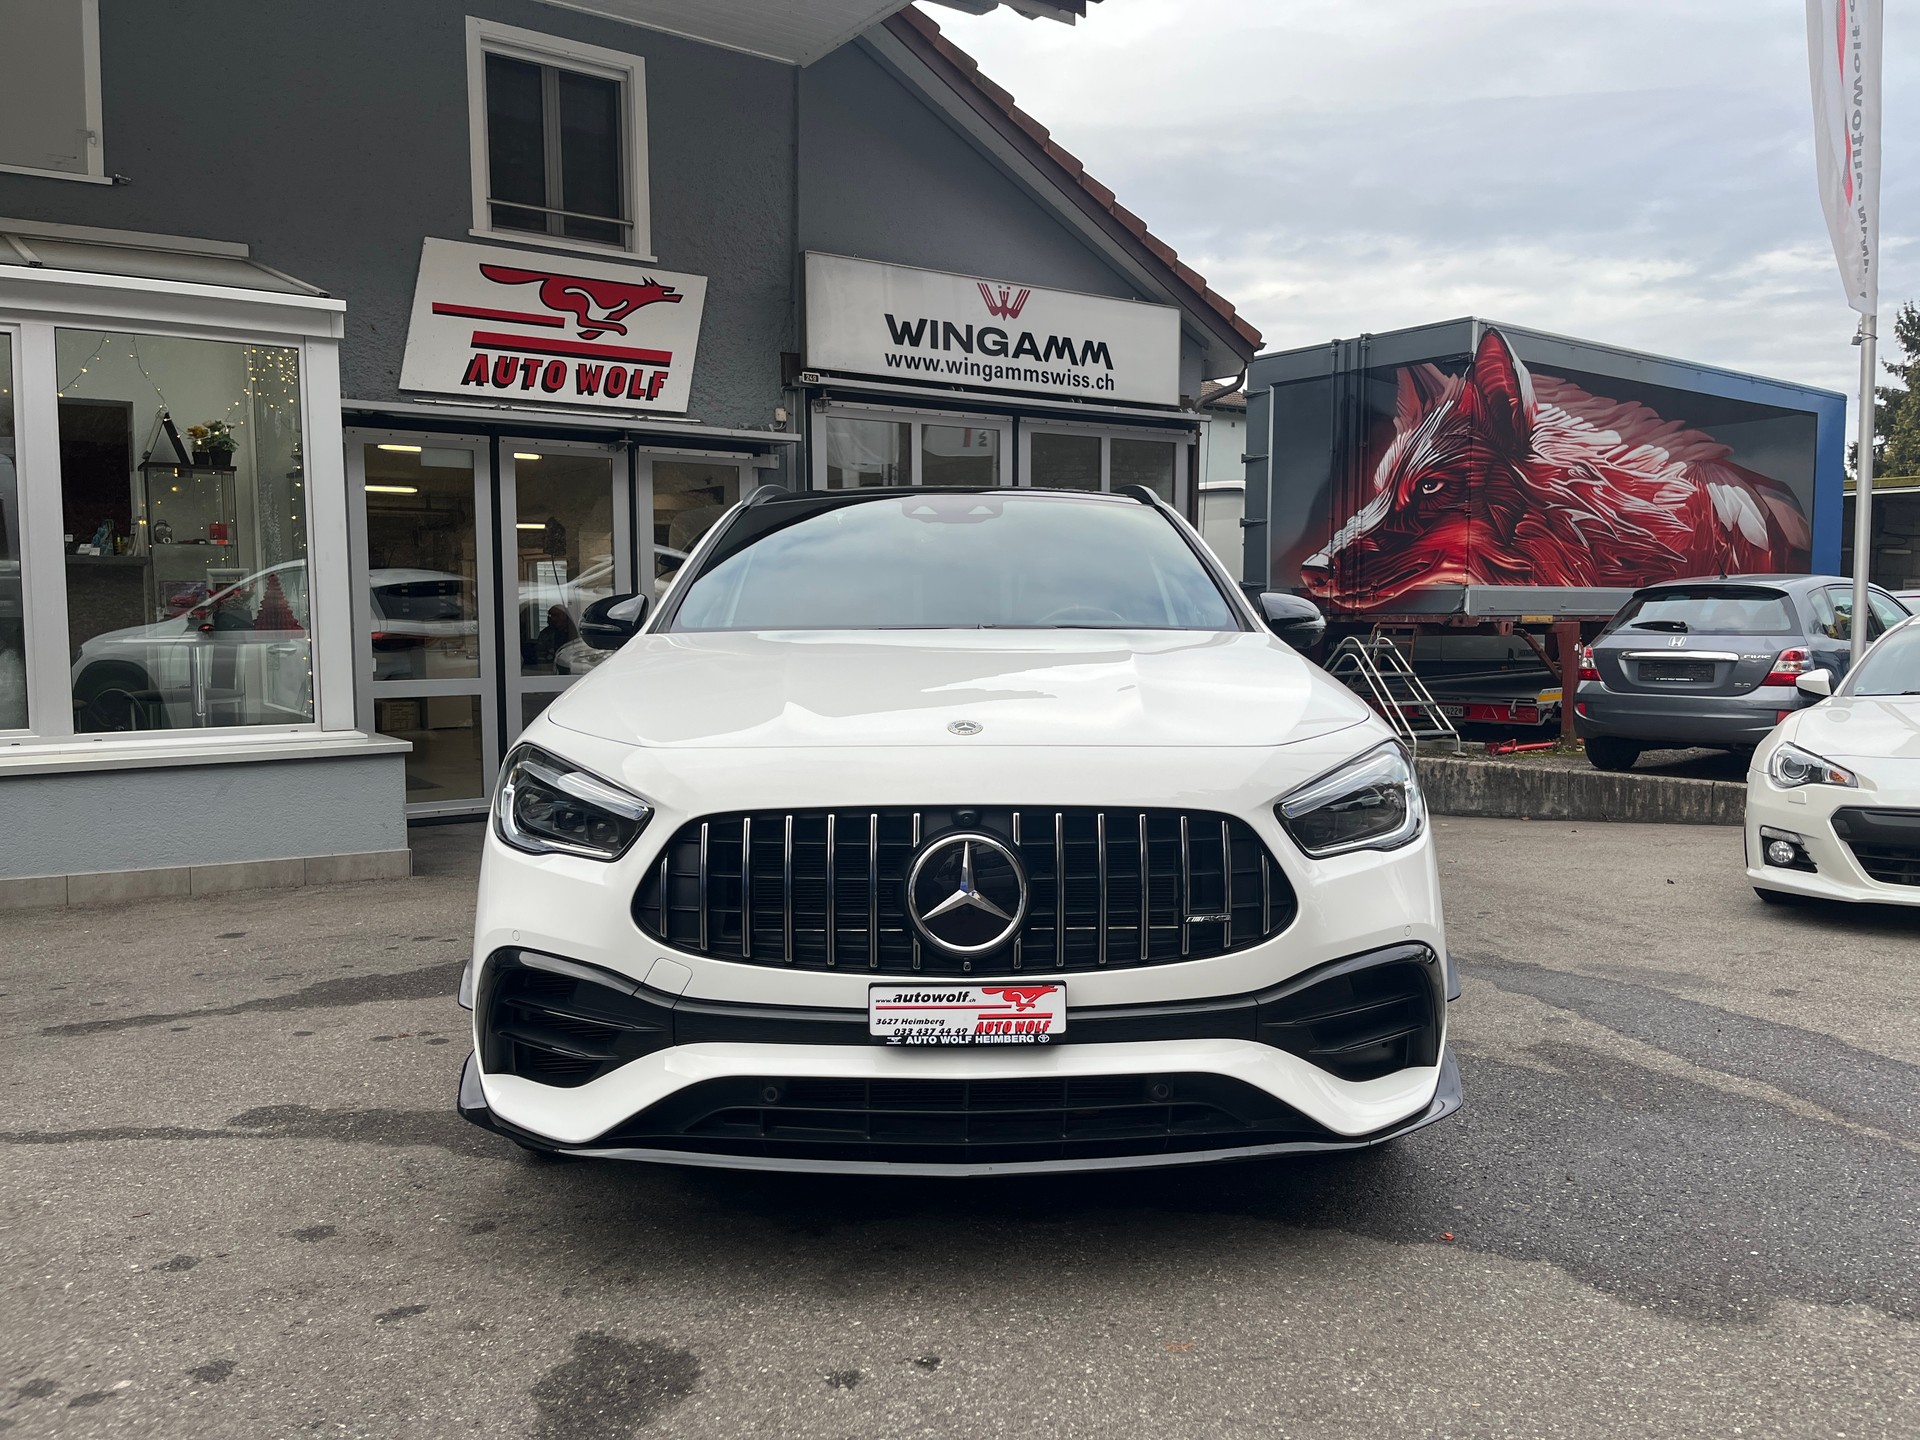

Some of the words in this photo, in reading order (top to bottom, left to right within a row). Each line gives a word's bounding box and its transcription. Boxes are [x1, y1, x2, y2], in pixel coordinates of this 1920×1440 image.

[884, 313, 1115, 371] WINGAMM
[460, 353, 567, 393] AUTO
[576, 363, 669, 401] WOLF
[884, 352, 1115, 391] www.wingammswiss.ch
[876, 991, 976, 1003] www.autowolf.ch
[901, 1018, 945, 1026] Heimberg
[974, 1020, 1012, 1035] AUTO
[1015, 1020, 1051, 1034] WOLF
[894, 1027, 914, 1036] 033
[916, 1027, 936, 1036] 437
[938, 1027, 951, 1036] 44
[954, 1027, 968, 1036] 49
[905, 1036, 938, 1044] AUTO
[940, 1036, 973, 1044] WOLF
[975, 1035, 1035, 1044] HEIMBERG
